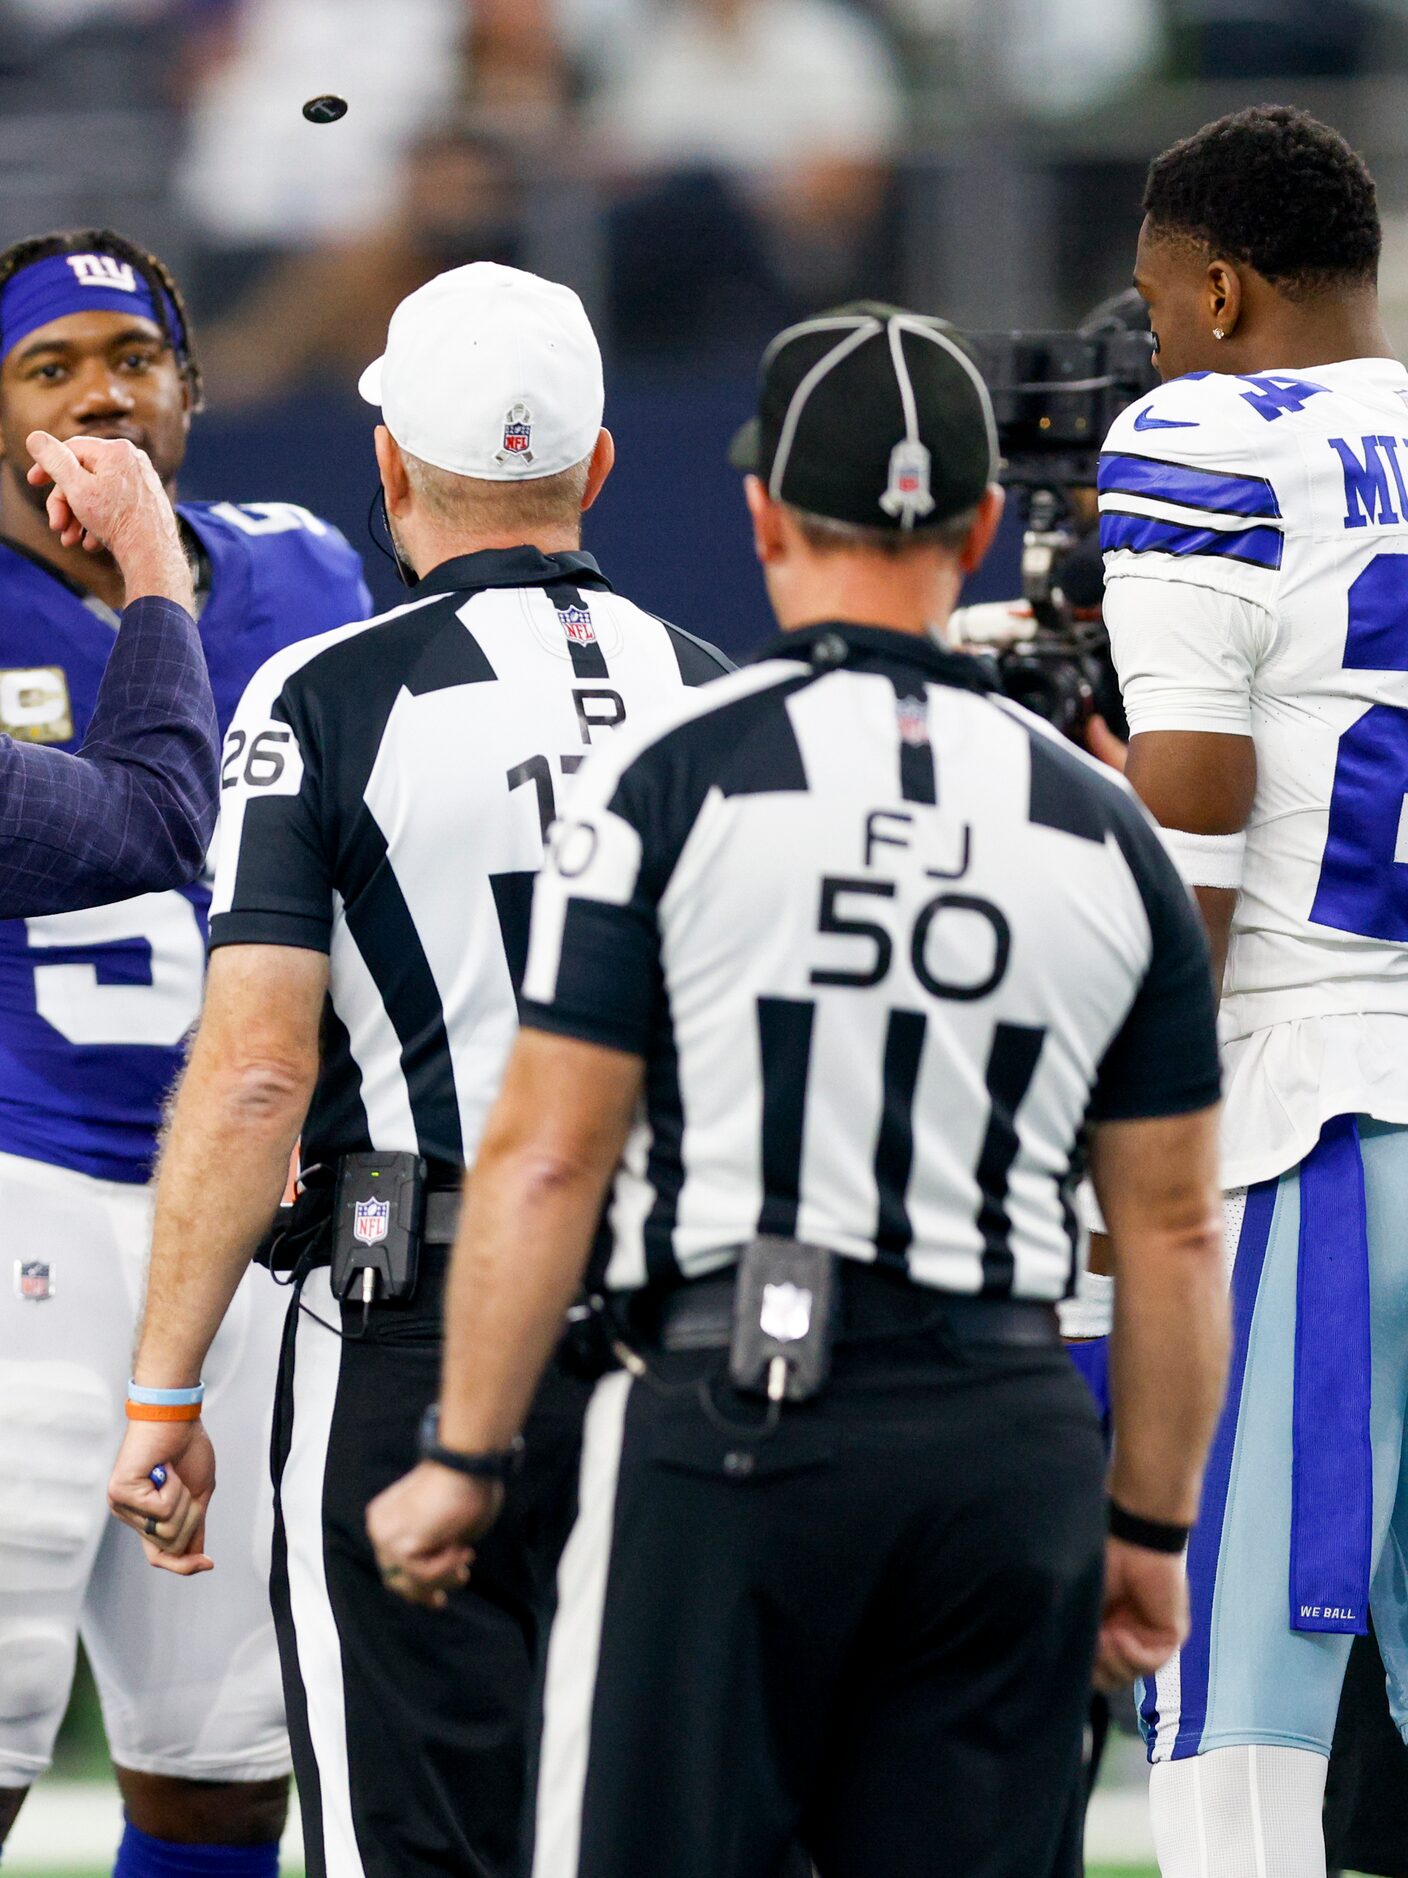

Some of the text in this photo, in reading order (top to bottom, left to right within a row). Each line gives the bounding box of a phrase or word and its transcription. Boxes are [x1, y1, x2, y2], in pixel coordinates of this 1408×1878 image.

[566, 623, 593, 640] NFL
[0, 671, 65, 728] C
[221, 729, 290, 790] 26
[809, 876, 1011, 1001] 50
[359, 1217, 383, 1237] NFL
[1300, 1605, 1321, 1618] WE
